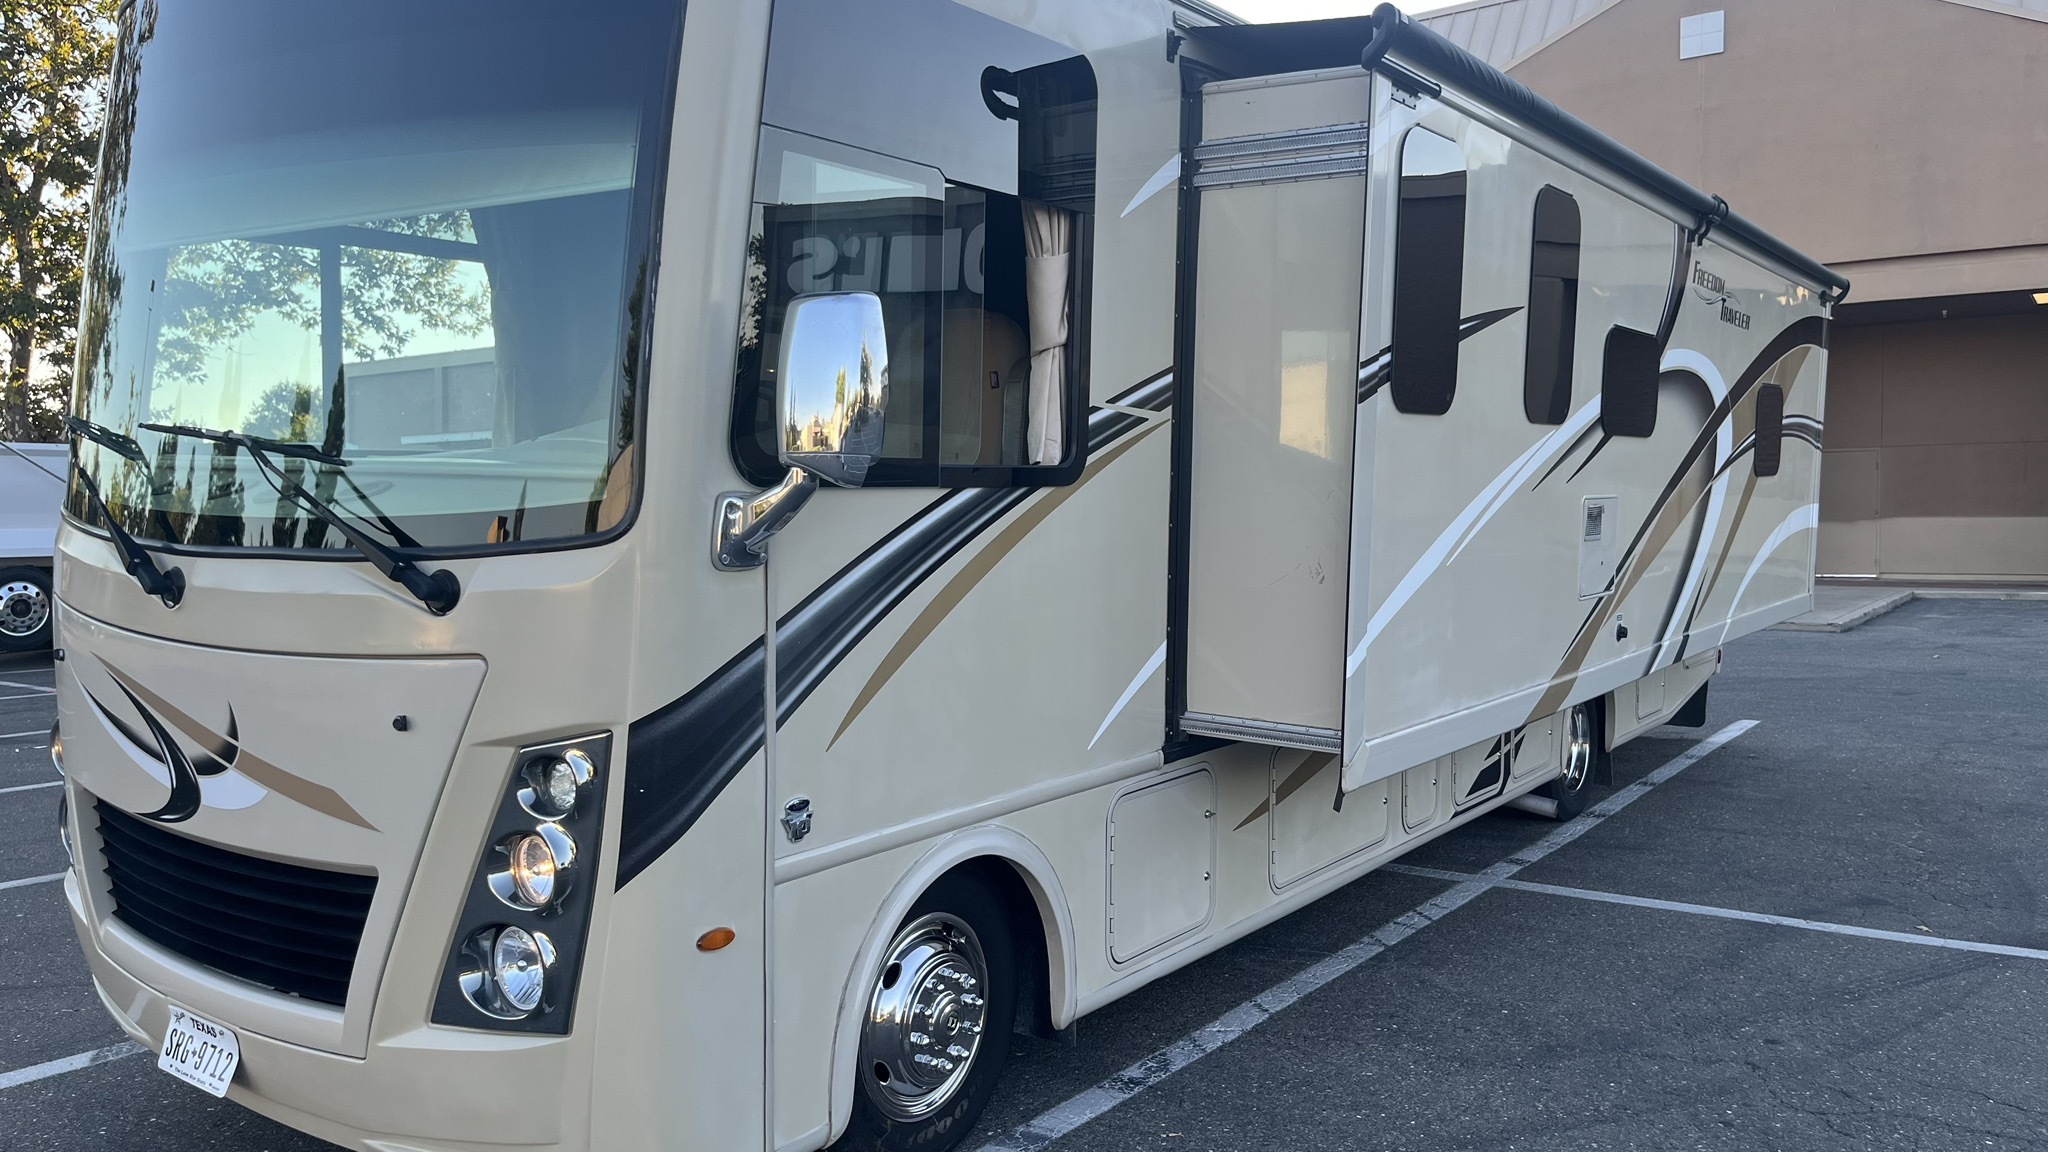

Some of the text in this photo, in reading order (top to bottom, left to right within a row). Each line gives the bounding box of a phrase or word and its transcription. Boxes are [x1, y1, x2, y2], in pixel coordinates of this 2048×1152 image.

[1692, 260, 1726, 295] FREEDOM
[1720, 297, 1751, 331] TRAVELER
[190, 1017, 217, 1038] TEXAS
[165, 1028, 233, 1082] SRG 9712
